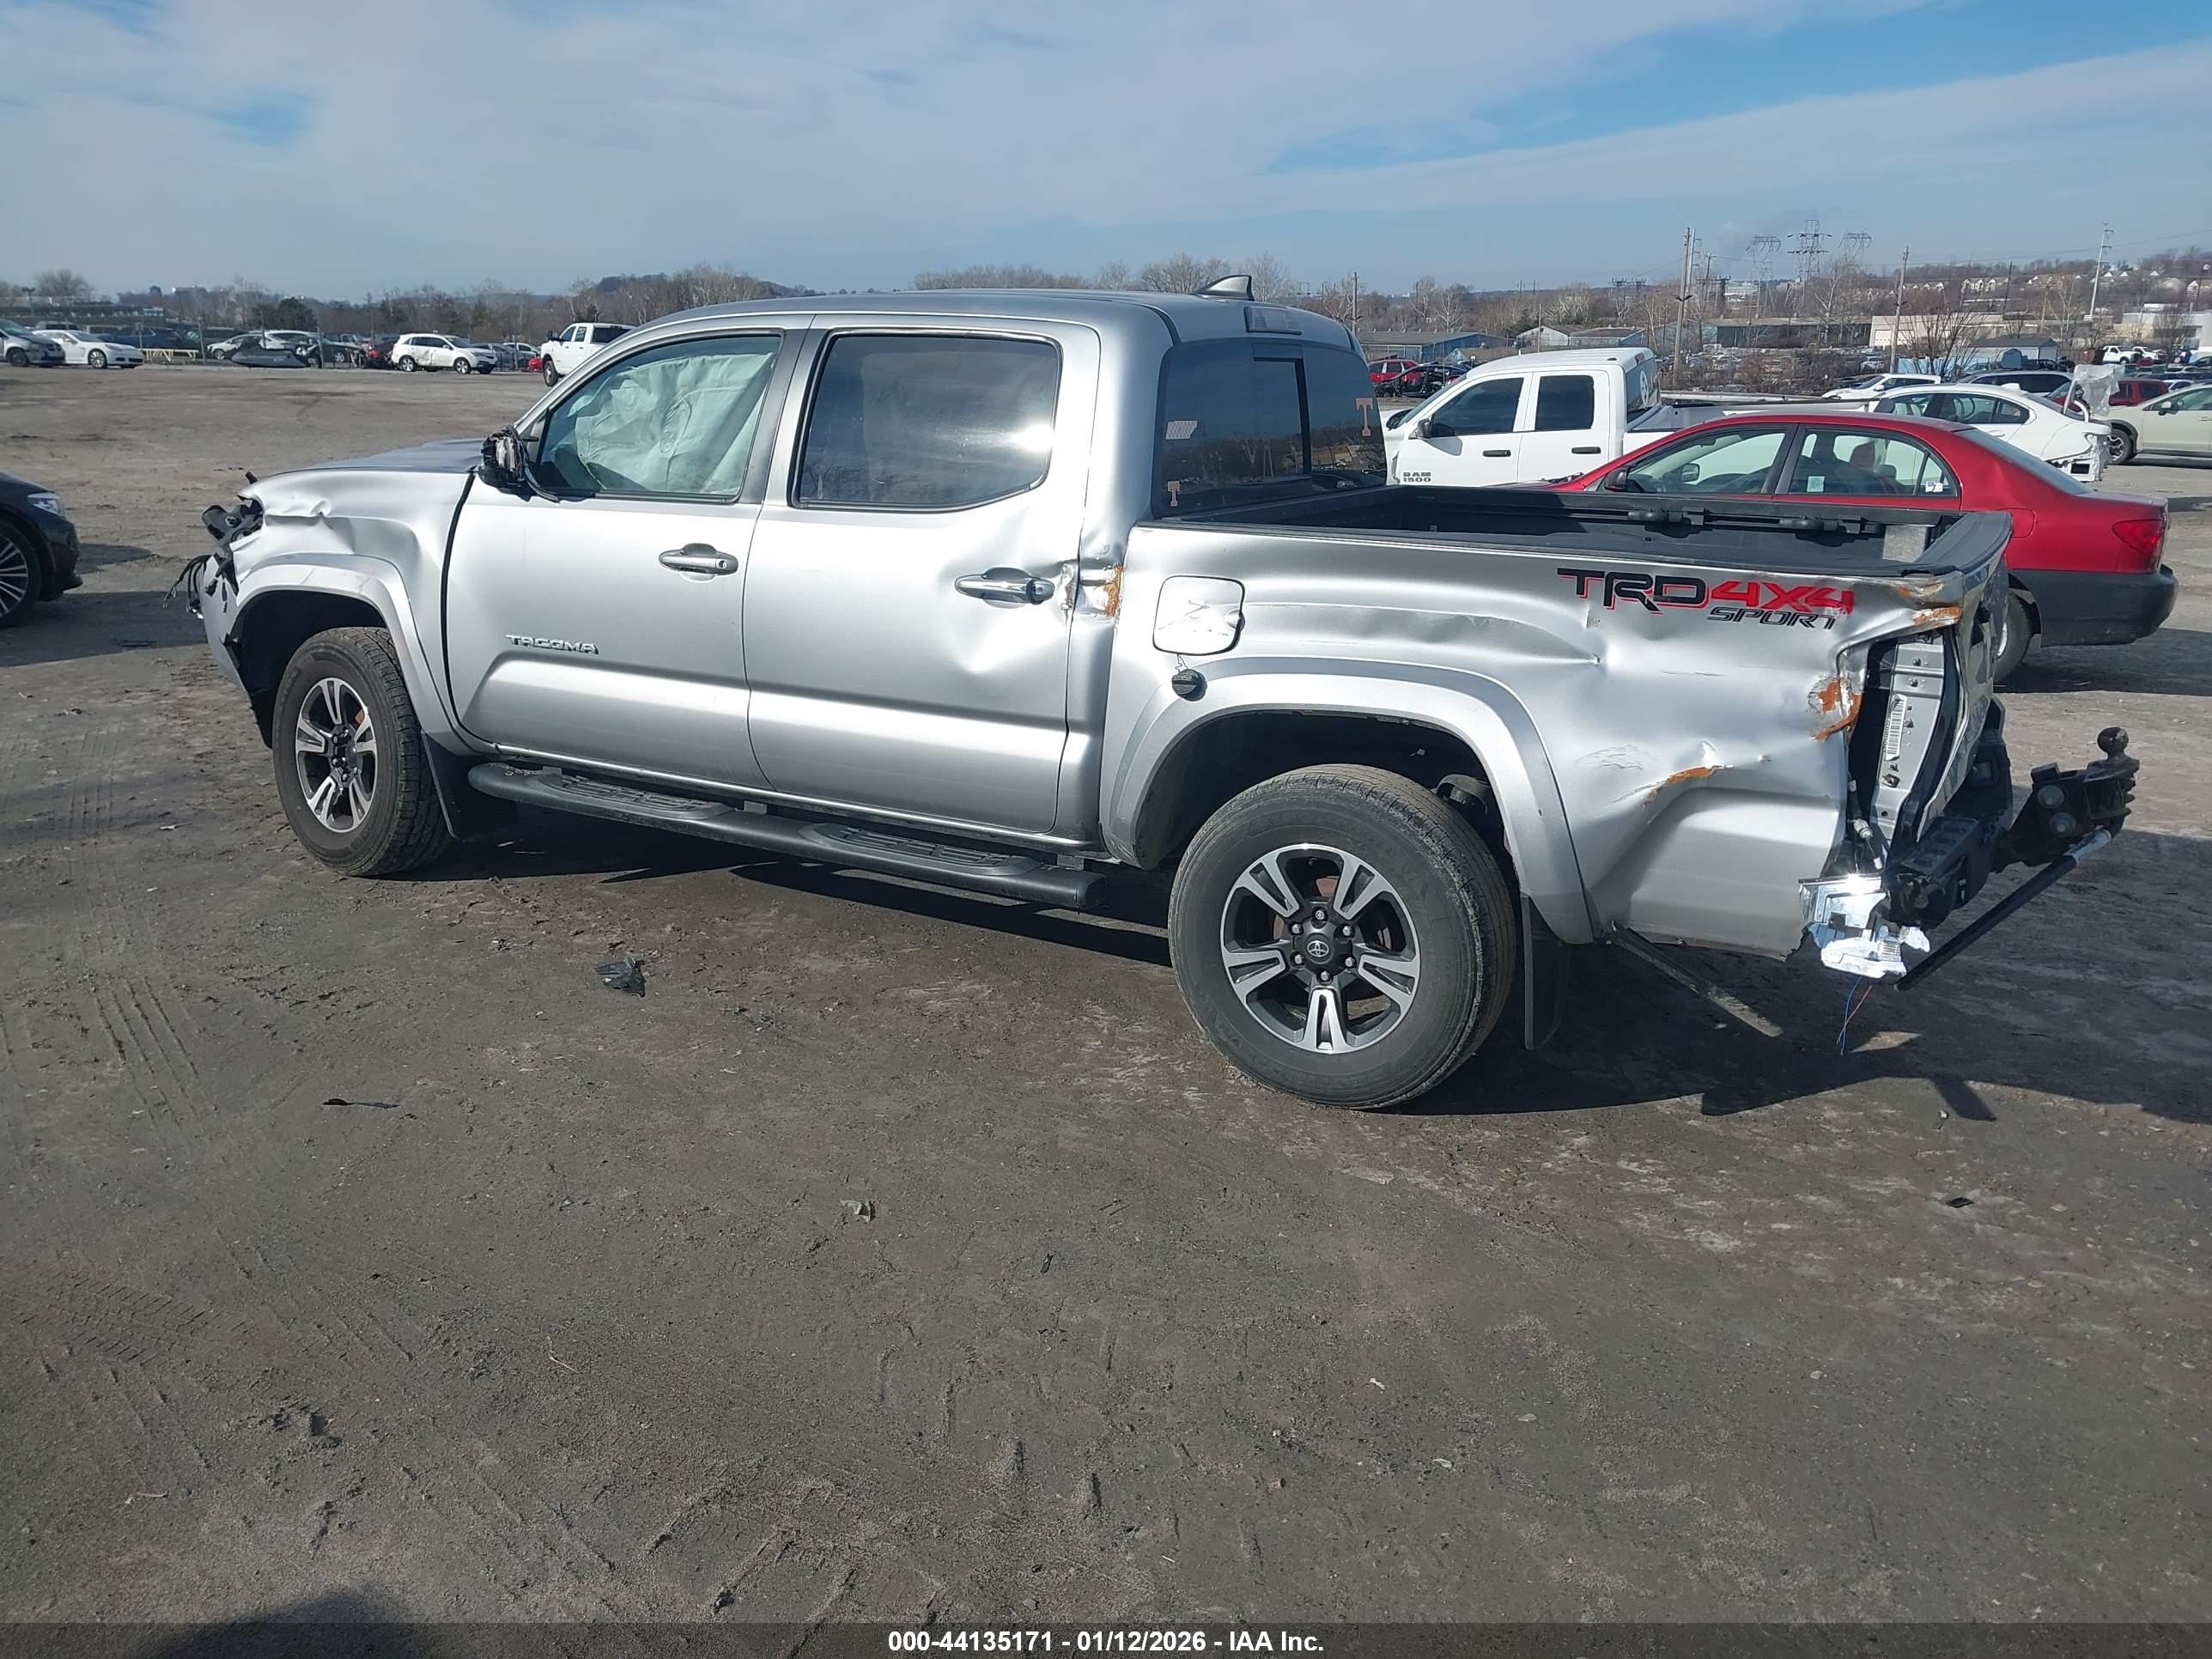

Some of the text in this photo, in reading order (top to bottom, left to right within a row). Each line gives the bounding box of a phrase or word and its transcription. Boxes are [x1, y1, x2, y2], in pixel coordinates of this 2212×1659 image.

[1557, 568, 1710, 616] TRD
[1706, 606, 1836, 629] SPORT
[506, 635, 599, 655] TACOMA
